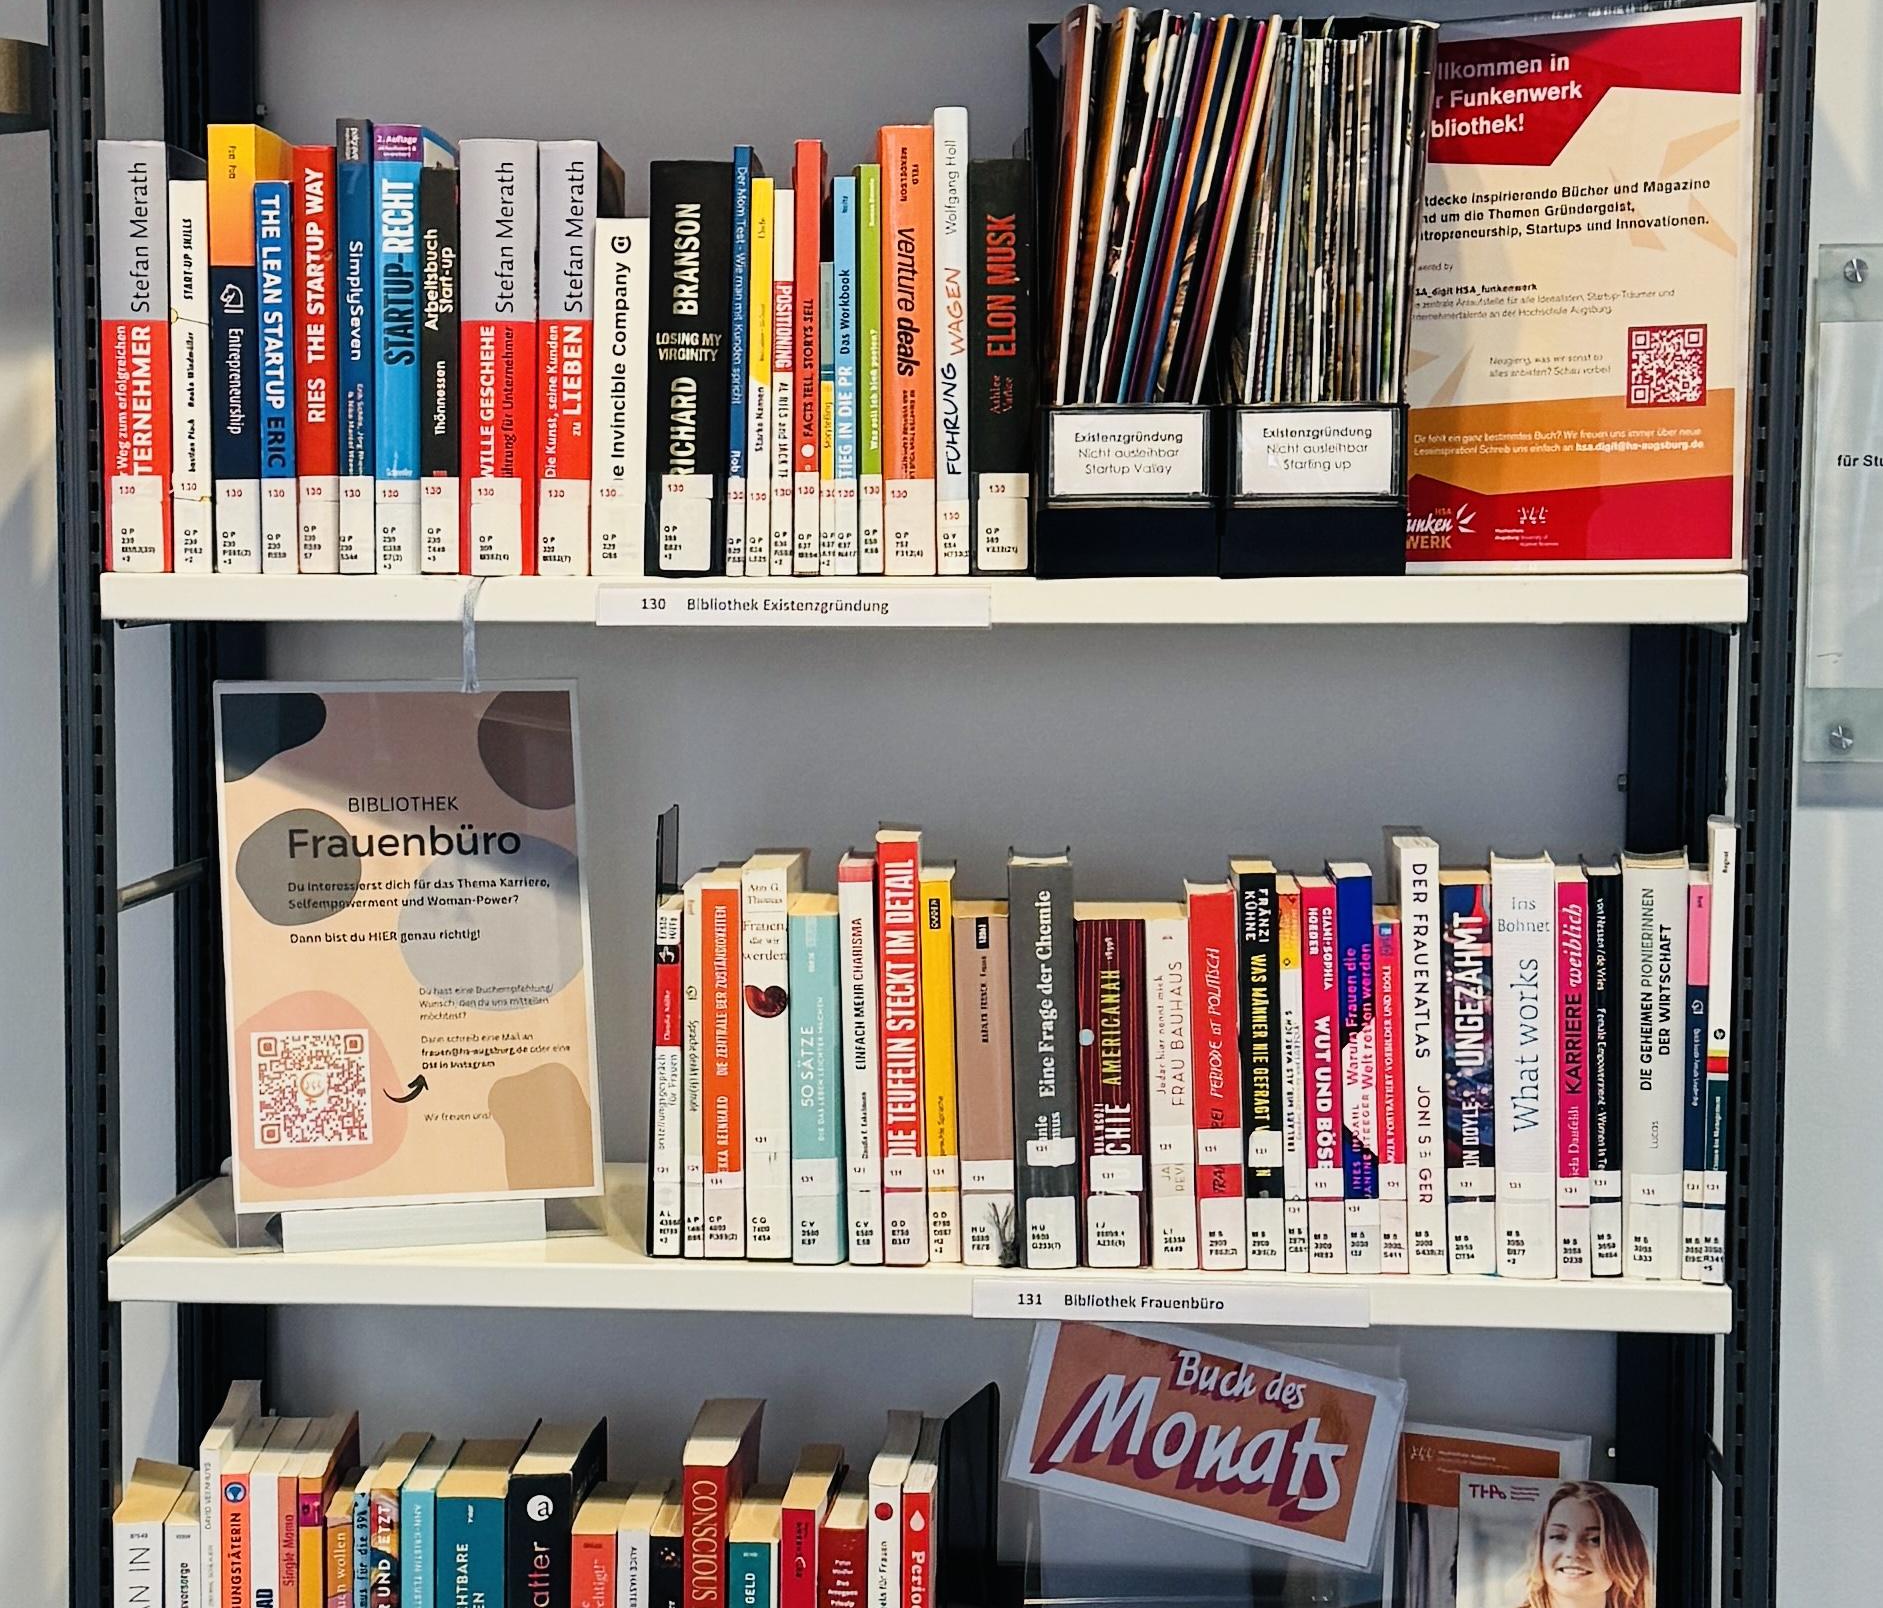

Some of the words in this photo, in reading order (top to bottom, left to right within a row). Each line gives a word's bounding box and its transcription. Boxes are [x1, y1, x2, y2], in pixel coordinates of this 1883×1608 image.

[1451, 80, 1583, 108] Funkenwerk
[1550, 54, 1569, 71] in
[1431, 114, 1524, 138] bliothek!
[128, 162, 149, 238] Merath
[261, 194, 280, 238] THE
[304, 167, 323, 215] WAY
[566, 160, 584, 238] Merath
[1562, 185, 1608, 199] Bücher
[129, 245, 149, 313] Stefan
[262, 242, 281, 303] LEAN
[305, 221, 324, 315] STARTUP
[381, 178, 416, 366] STARTUP-RECHT
[423, 229, 439, 330] Arbeitsbuch
[439, 247, 456, 313] Start-up
[565, 244, 584, 312] Stefan
[673, 203, 702, 315] BRANSON
[896, 227, 915, 312] venture
[986, 213, 1017, 285] MUSK
[346, 241, 364, 361] SimplySeven
[611, 262, 631, 356] Company
[774, 284, 792, 368] POSITIONING
[944, 267, 966, 356] WAGEN
[985, 294, 1017, 357] ELON
[264, 311, 285, 409] STARTUP
[306, 323, 325, 362] THE
[479, 325, 495, 421] GESCHEHE
[564, 325, 583, 416] LIEBEN
[658, 348, 719, 362] VIRGINITY
[896, 318, 914, 376] deals
[308, 378, 326, 423] RIES
[433, 361, 447, 435] Thönnessen
[610, 363, 627, 458] Invincible
[670, 376, 698, 477] RICHARD
[266, 417, 286, 468] ERIC
[1075, 430, 1183, 445] Existenzgründung
[1263, 426, 1372, 440] Existenzgründung
[1837, 454, 1859, 467] für
[641, 598, 666, 610] 130
[687, 597, 759, 611] Bibliothek
[763, 598, 889, 614] Existenzgründung
[348, 796, 459, 813] BIBLIOTHEK
[288, 824, 521, 859] Frauenbüro
[457, 878, 496, 889] Thema
[885, 859, 914, 924] DETAIL
[1412, 862, 1428, 903] DER
[1513, 898, 1537, 911] Ins
[369, 931, 397, 941] HIER
[851, 918, 864, 981] CHARISMA
[885, 931, 915, 955] IM
[1035, 890, 1052, 958] Chemie
[1497, 918, 1551, 933] Bohnet
[1564, 903, 1585, 987] weiblich
[1641, 888, 1655, 987] PIONIERINNEN
[886, 961, 916, 1031] STECKT
[1036, 964, 1054, 995] der
[1413, 913, 1431, 1060] FRAUENATLAS
[1452, 911, 1486, 1067] UNGEZÄHMT
[1513, 958, 1538, 1046] works
[1659, 924, 1672, 1023] WIRTSCHAFT
[1038, 999, 1058, 1052] Frage
[1101, 969, 1122, 1086] AMERICANAH
[1170, 961, 1184, 1050] BAUHAUS
[1640, 990, 1654, 1064] GEHEIMEN
[797, 1026, 815, 1080] SÄTZE
[1313, 1016, 1331, 1062] WUT
[1566, 994, 1583, 1095] KARRIERE
[1659, 1027, 1672, 1056] DER
[801, 1085, 814, 1108] 50
[887, 1040, 917, 1125] TEUFELIN
[1038, 1057, 1056, 1098] Eine
[1171, 1058, 1185, 1106] FRAU
[1316, 1067, 1333, 1112] UND
[1417, 1085, 1432, 1128] JONI
[1511, 1056, 1538, 1131] What
[1640, 1068, 1654, 1091] DIE
[1017, 1293, 1042, 1306] 131
[1064, 1293, 1137, 1309] Bibliothek
[1141, 1296, 1224, 1311] Frauenbüro
[1175, 1349, 1256, 1397] Buch
[1265, 1371, 1306, 1410] des
[1049, 1374, 1348, 1511] Monats
[127, 1547, 150, 1572] IN
[691, 1480, 718, 1601] CONSCIOUS
[744, 1572, 756, 1604] GELD
